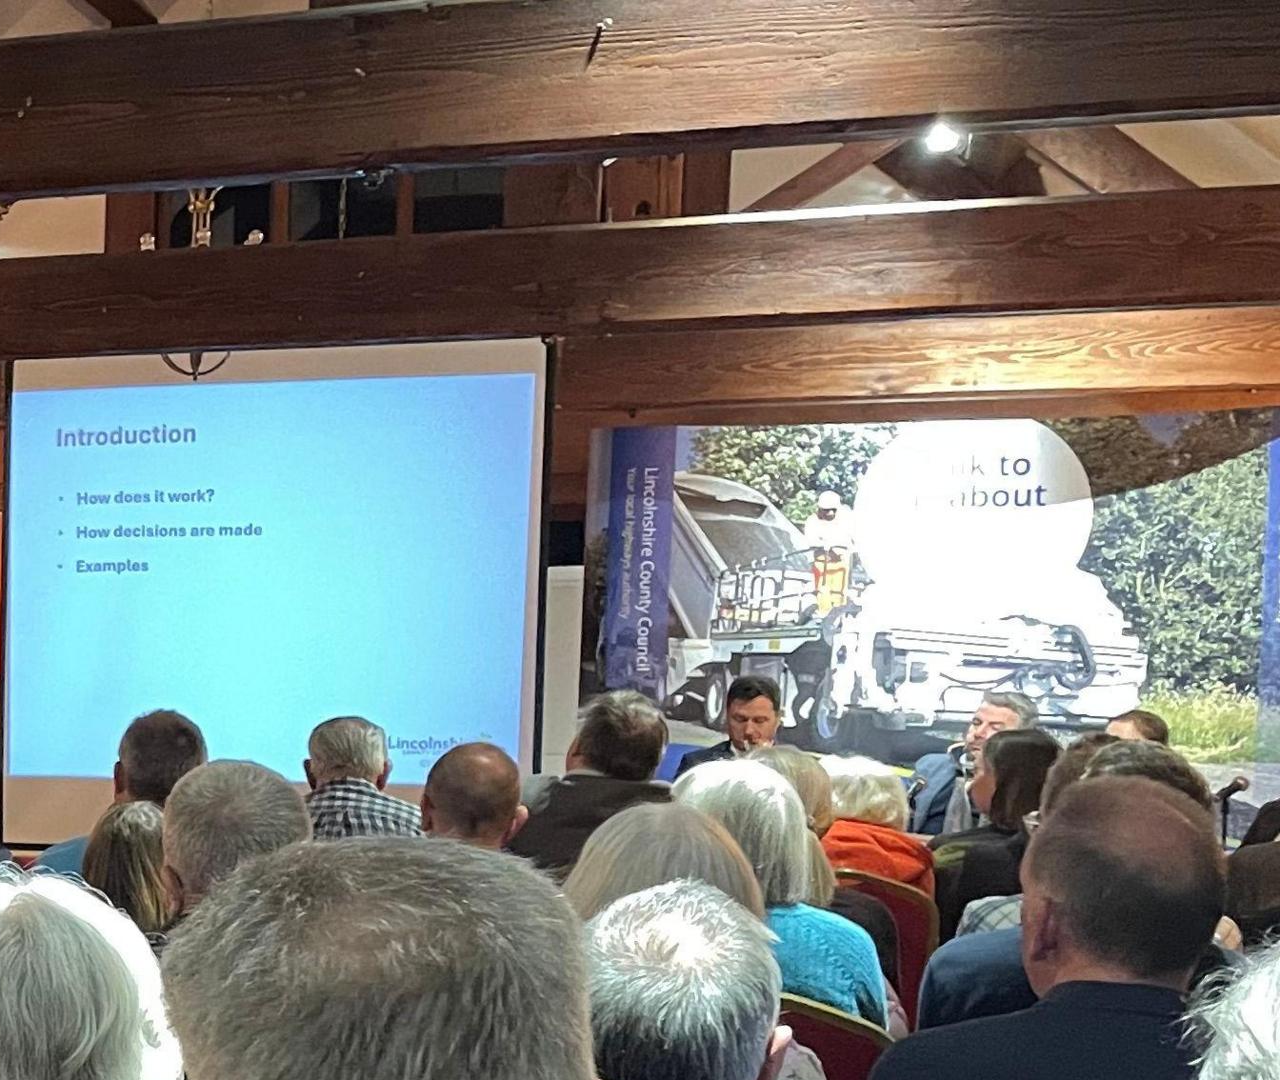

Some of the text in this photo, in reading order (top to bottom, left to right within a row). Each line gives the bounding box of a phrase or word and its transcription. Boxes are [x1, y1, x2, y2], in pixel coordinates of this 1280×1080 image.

[56, 424, 197, 447] Introduction
[1000, 456, 1031, 476] to
[76, 488, 215, 505] How does it work?
[76, 523, 263, 539] How decisions are made
[75, 558, 149, 575] Examples
[634, 467, 660, 672] Lincolnshire County Council
